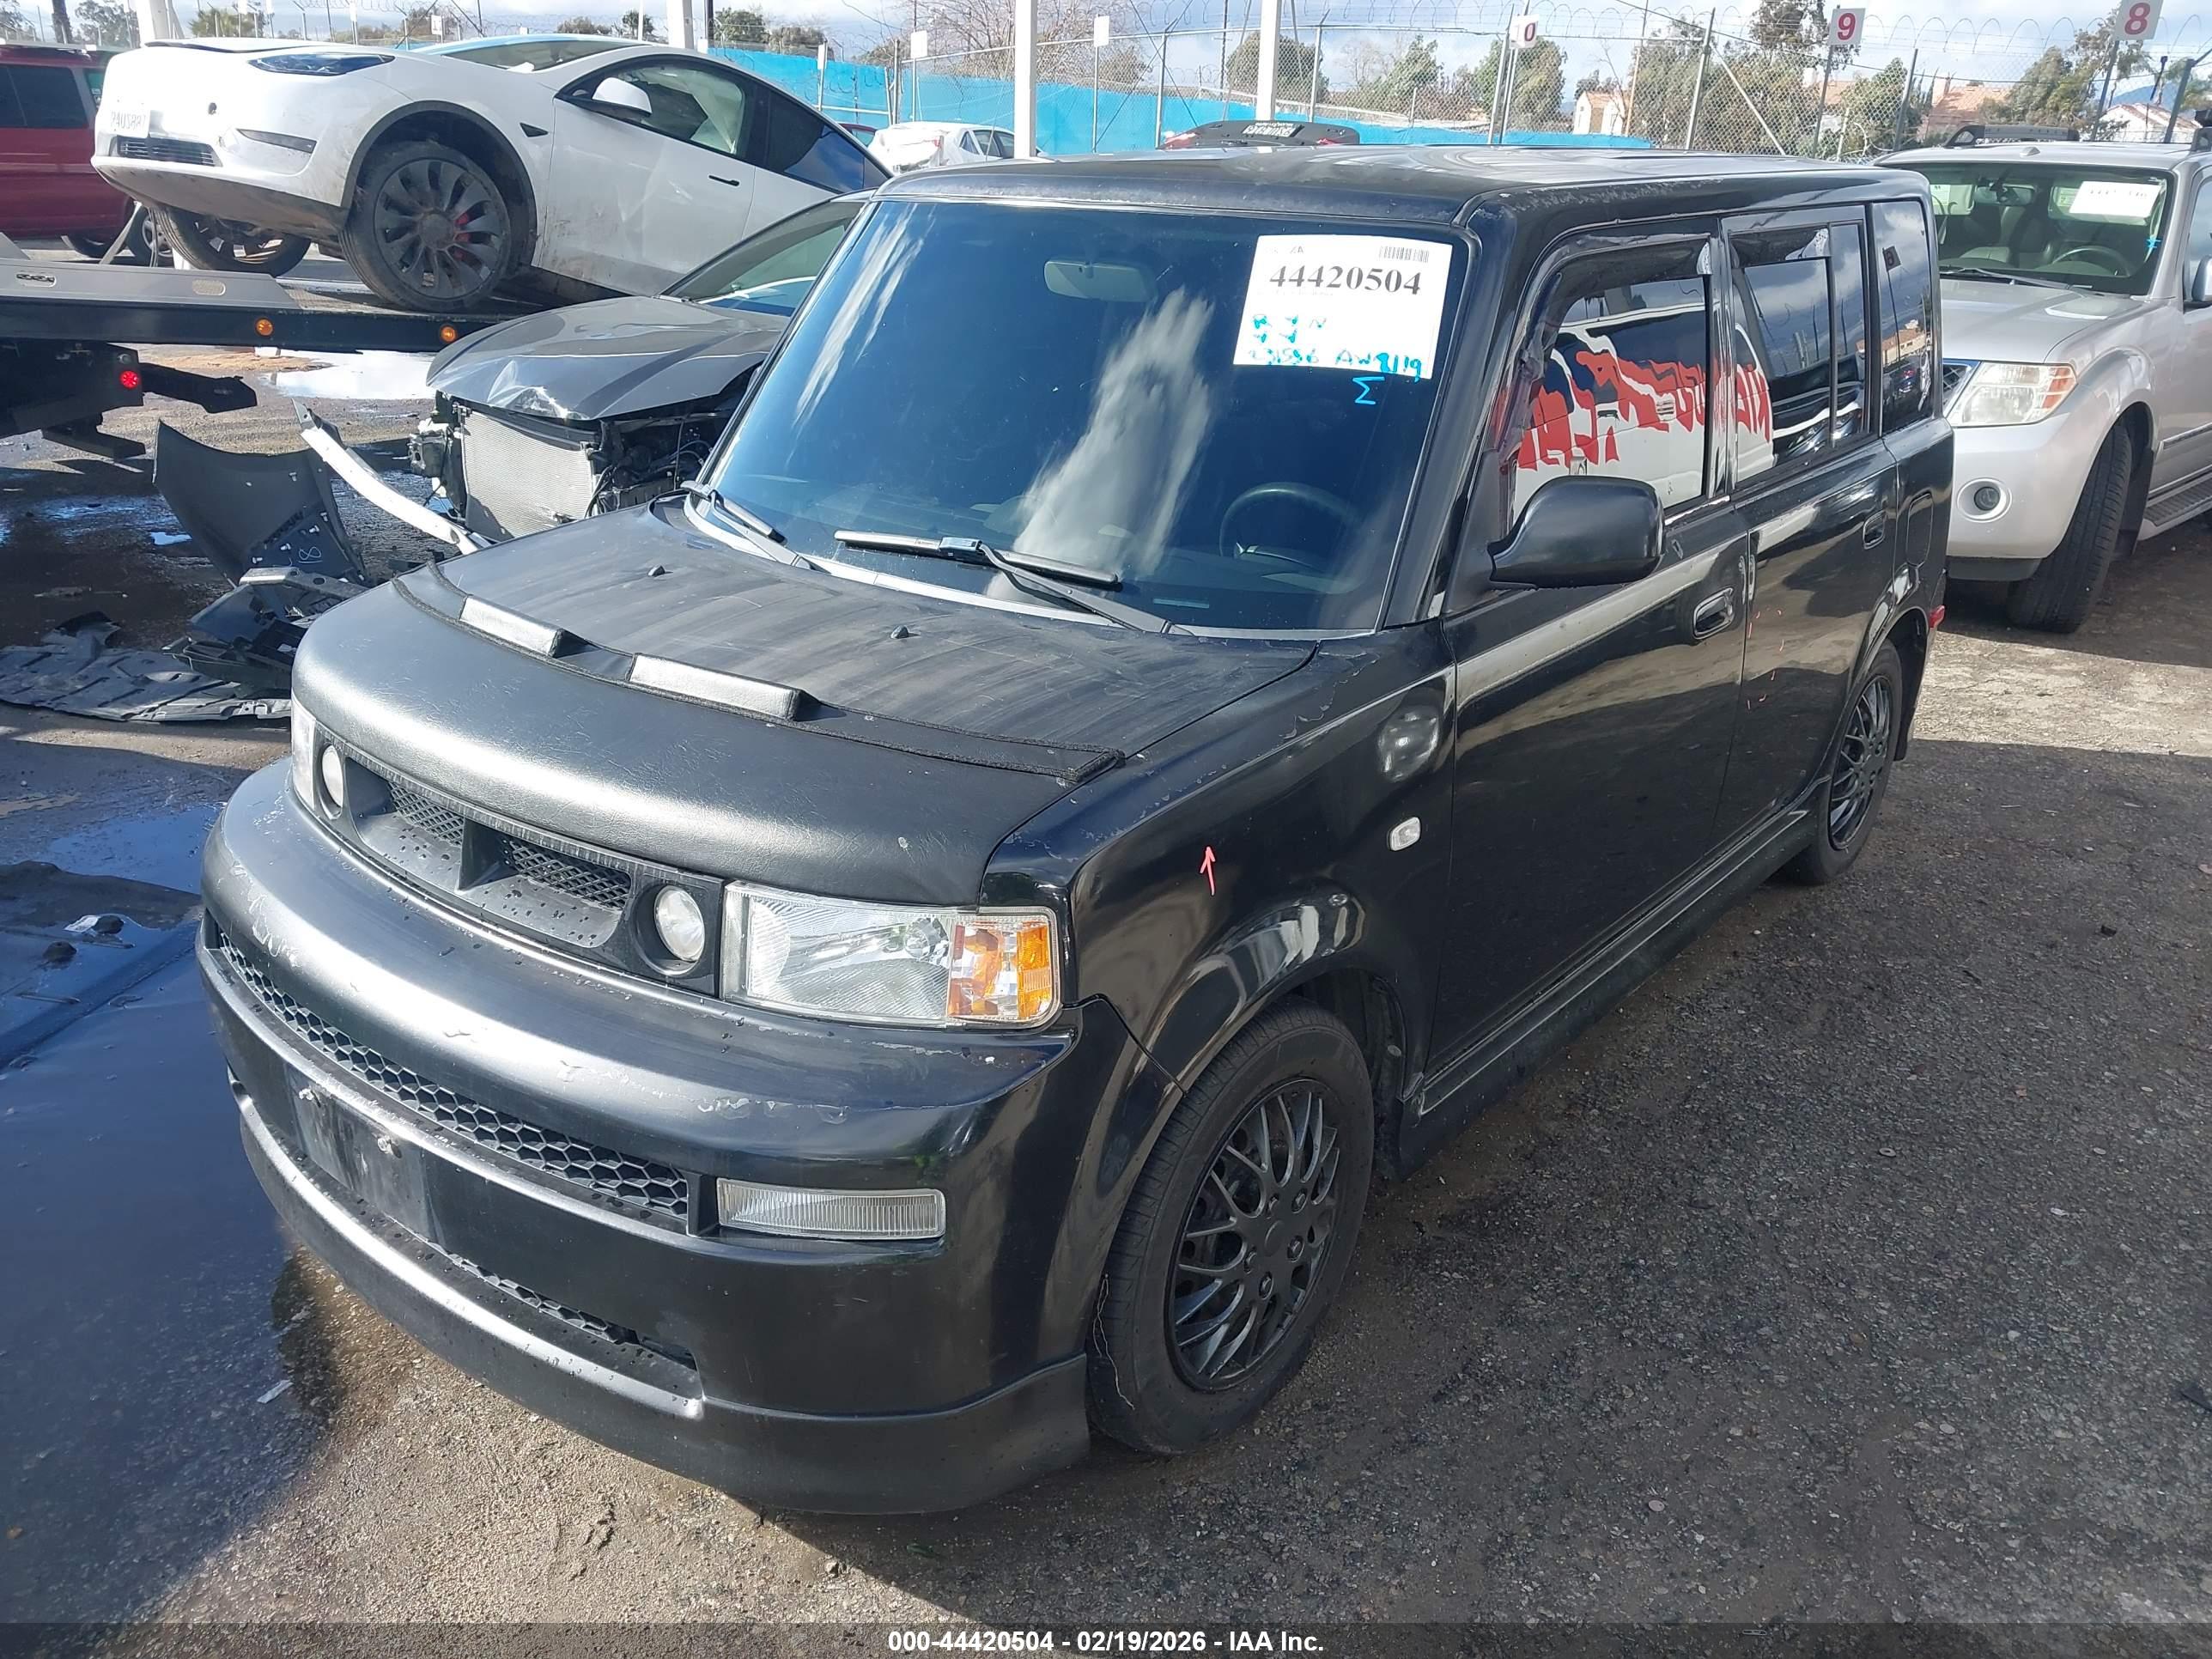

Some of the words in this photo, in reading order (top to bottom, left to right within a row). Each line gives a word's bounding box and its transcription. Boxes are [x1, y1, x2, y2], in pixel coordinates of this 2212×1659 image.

[1838, 13, 1856, 40] 9
[2124, 3, 2150, 35] 8
[1269, 265, 1422, 295] 44420504
